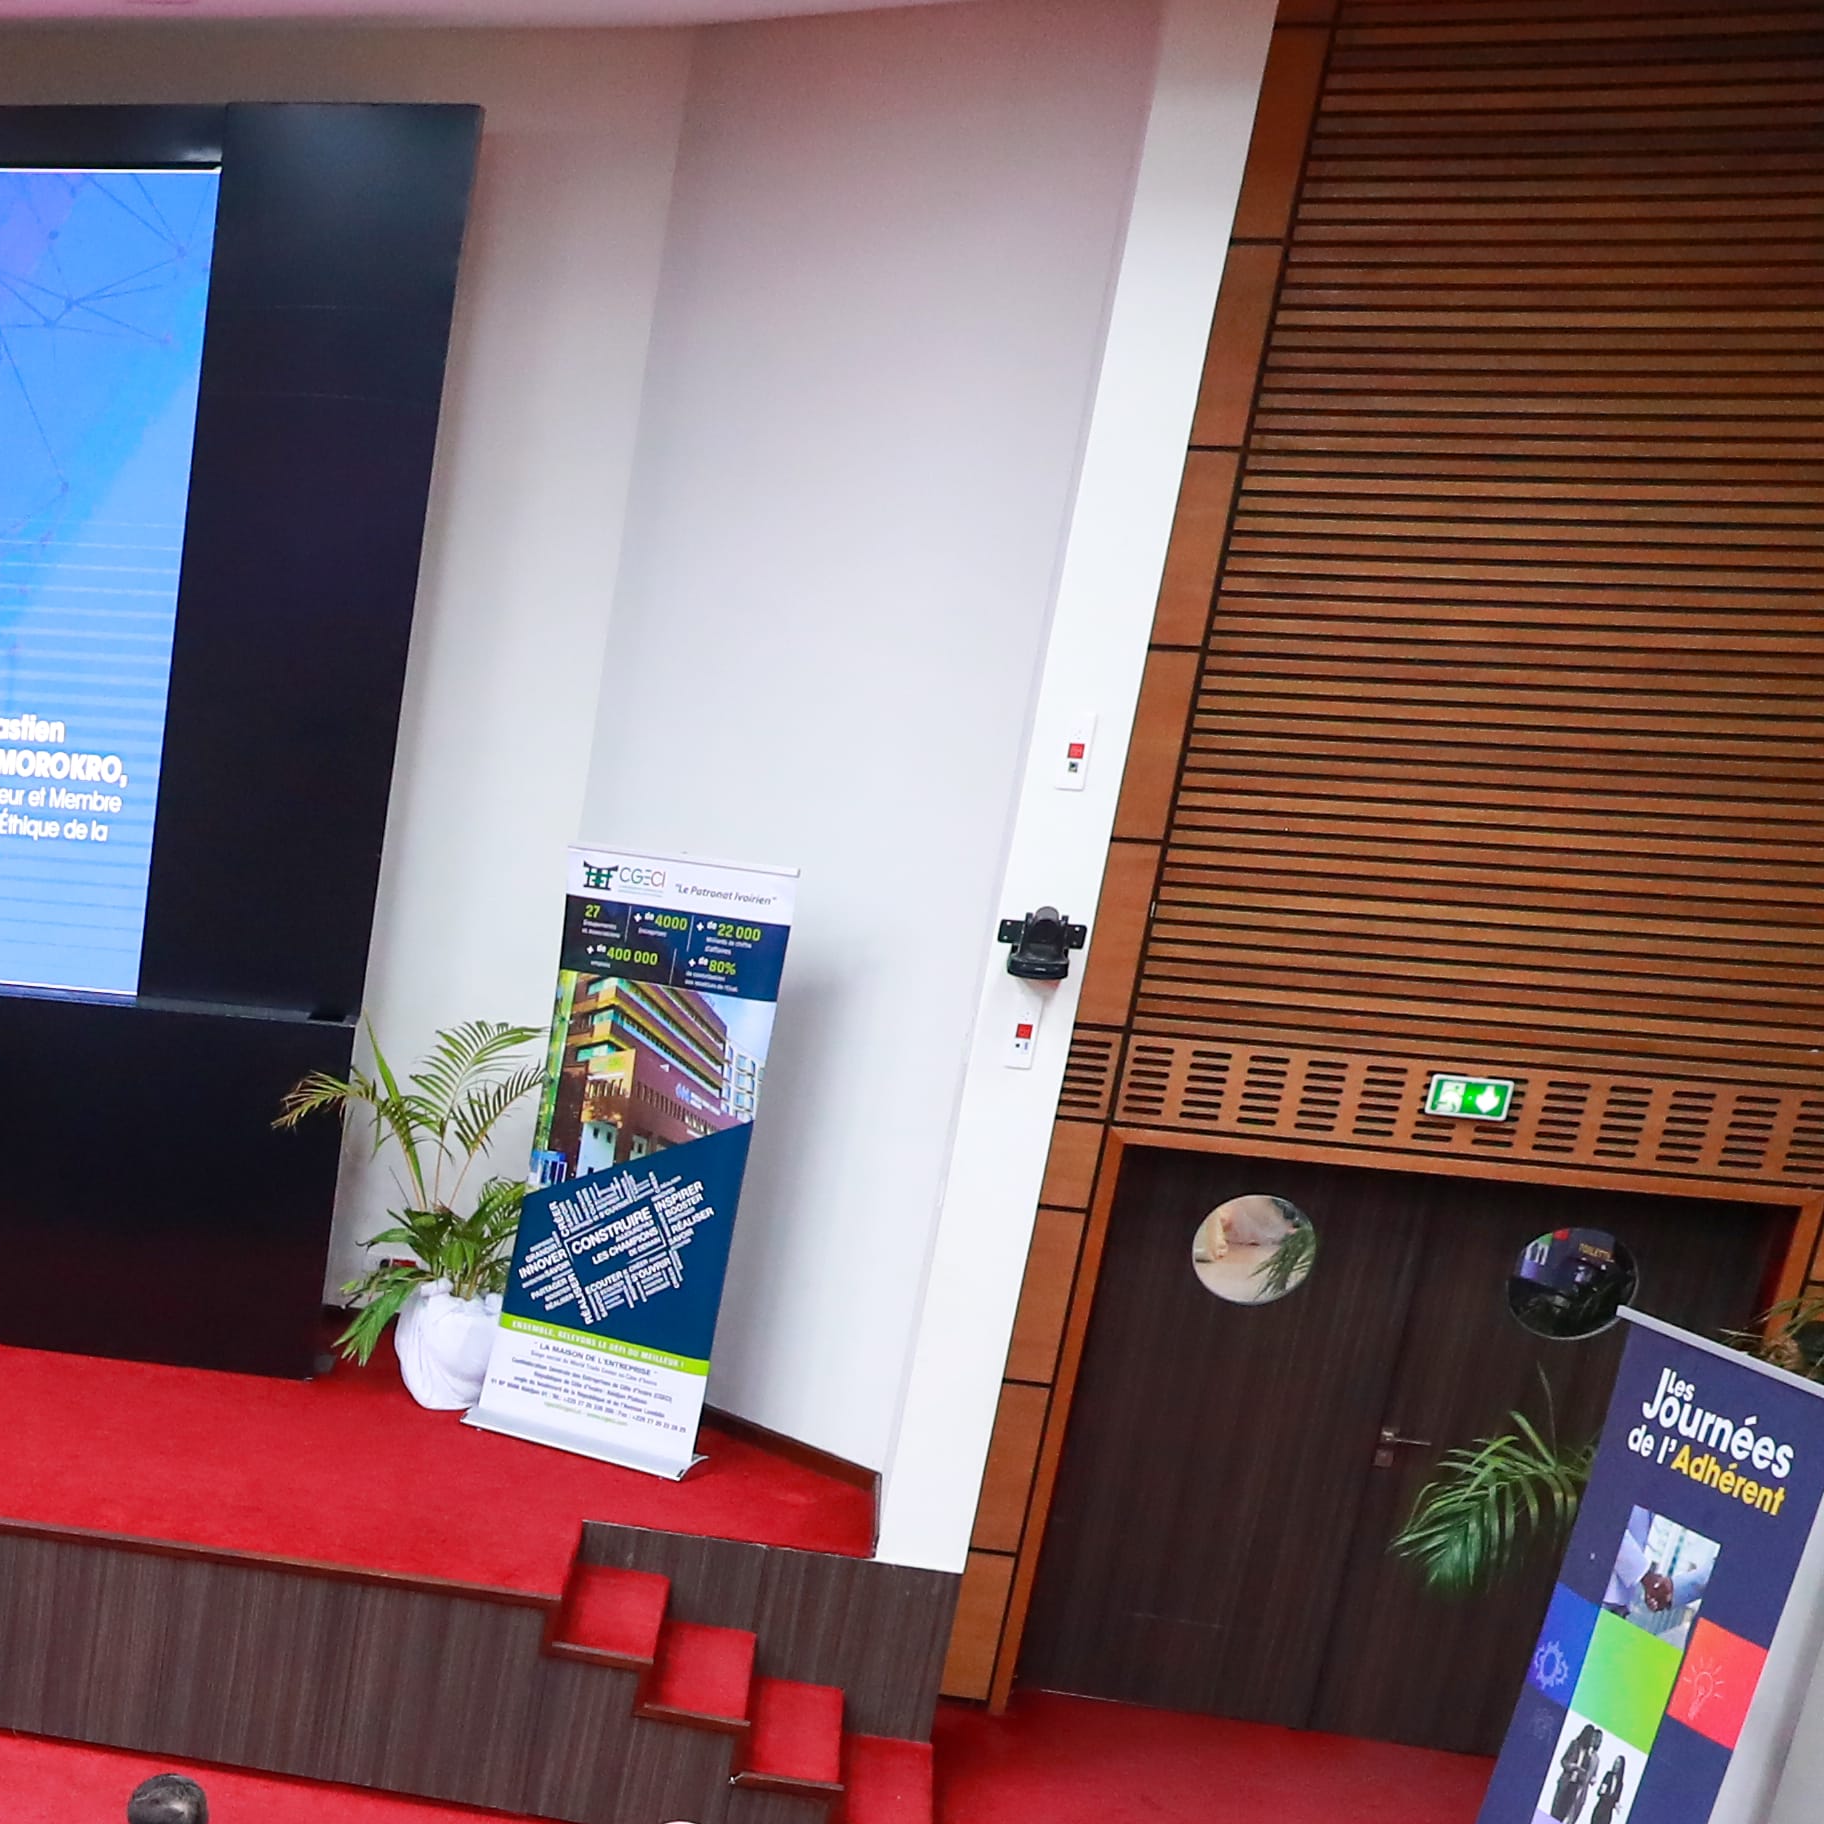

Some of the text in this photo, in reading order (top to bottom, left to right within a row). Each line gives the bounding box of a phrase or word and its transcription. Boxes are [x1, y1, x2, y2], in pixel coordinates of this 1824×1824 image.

[28, 787, 46, 808] et
[49, 787, 122, 814] Membre
[63, 819, 88, 839] de
[91, 820, 108, 842] la
[619, 866, 666, 888] CGECI
[690, 885, 732, 899] Patronat
[585, 905, 601, 919] 27
[645, 912, 655, 921] de
[655, 914, 688, 930] 4000
[707, 920, 717, 930] de
[717, 923, 734, 939] 22
[735, 926, 761, 942] 000
[597, 943, 607, 953] de
[607, 946, 631, 961] 400
[634, 950, 658, 966] 000
[698, 957, 708, 966] de
[709, 959, 736, 976] 80%
[654, 1180, 704, 1213] INSPIRER
[664, 1194, 703, 1218] BOOSTER
[548, 1200, 570, 1238] CRÉER
[571, 1206, 653, 1255] CONSTRUIRE
[671, 1207, 715, 1234] RÉALISER
[592, 1226, 659, 1265] LES CHAMPIONS
[518, 1249, 569, 1279] INNOVER
[631, 1257, 672, 1283] S'OUVRIR
[552, 1345, 584, 1359] MAISON
[585, 1353, 597, 1362] DE
[1667, 1371, 1695, 1401] Les
[1642, 1368, 1794, 1478] Journées
[1628, 1425, 1654, 1457] de
